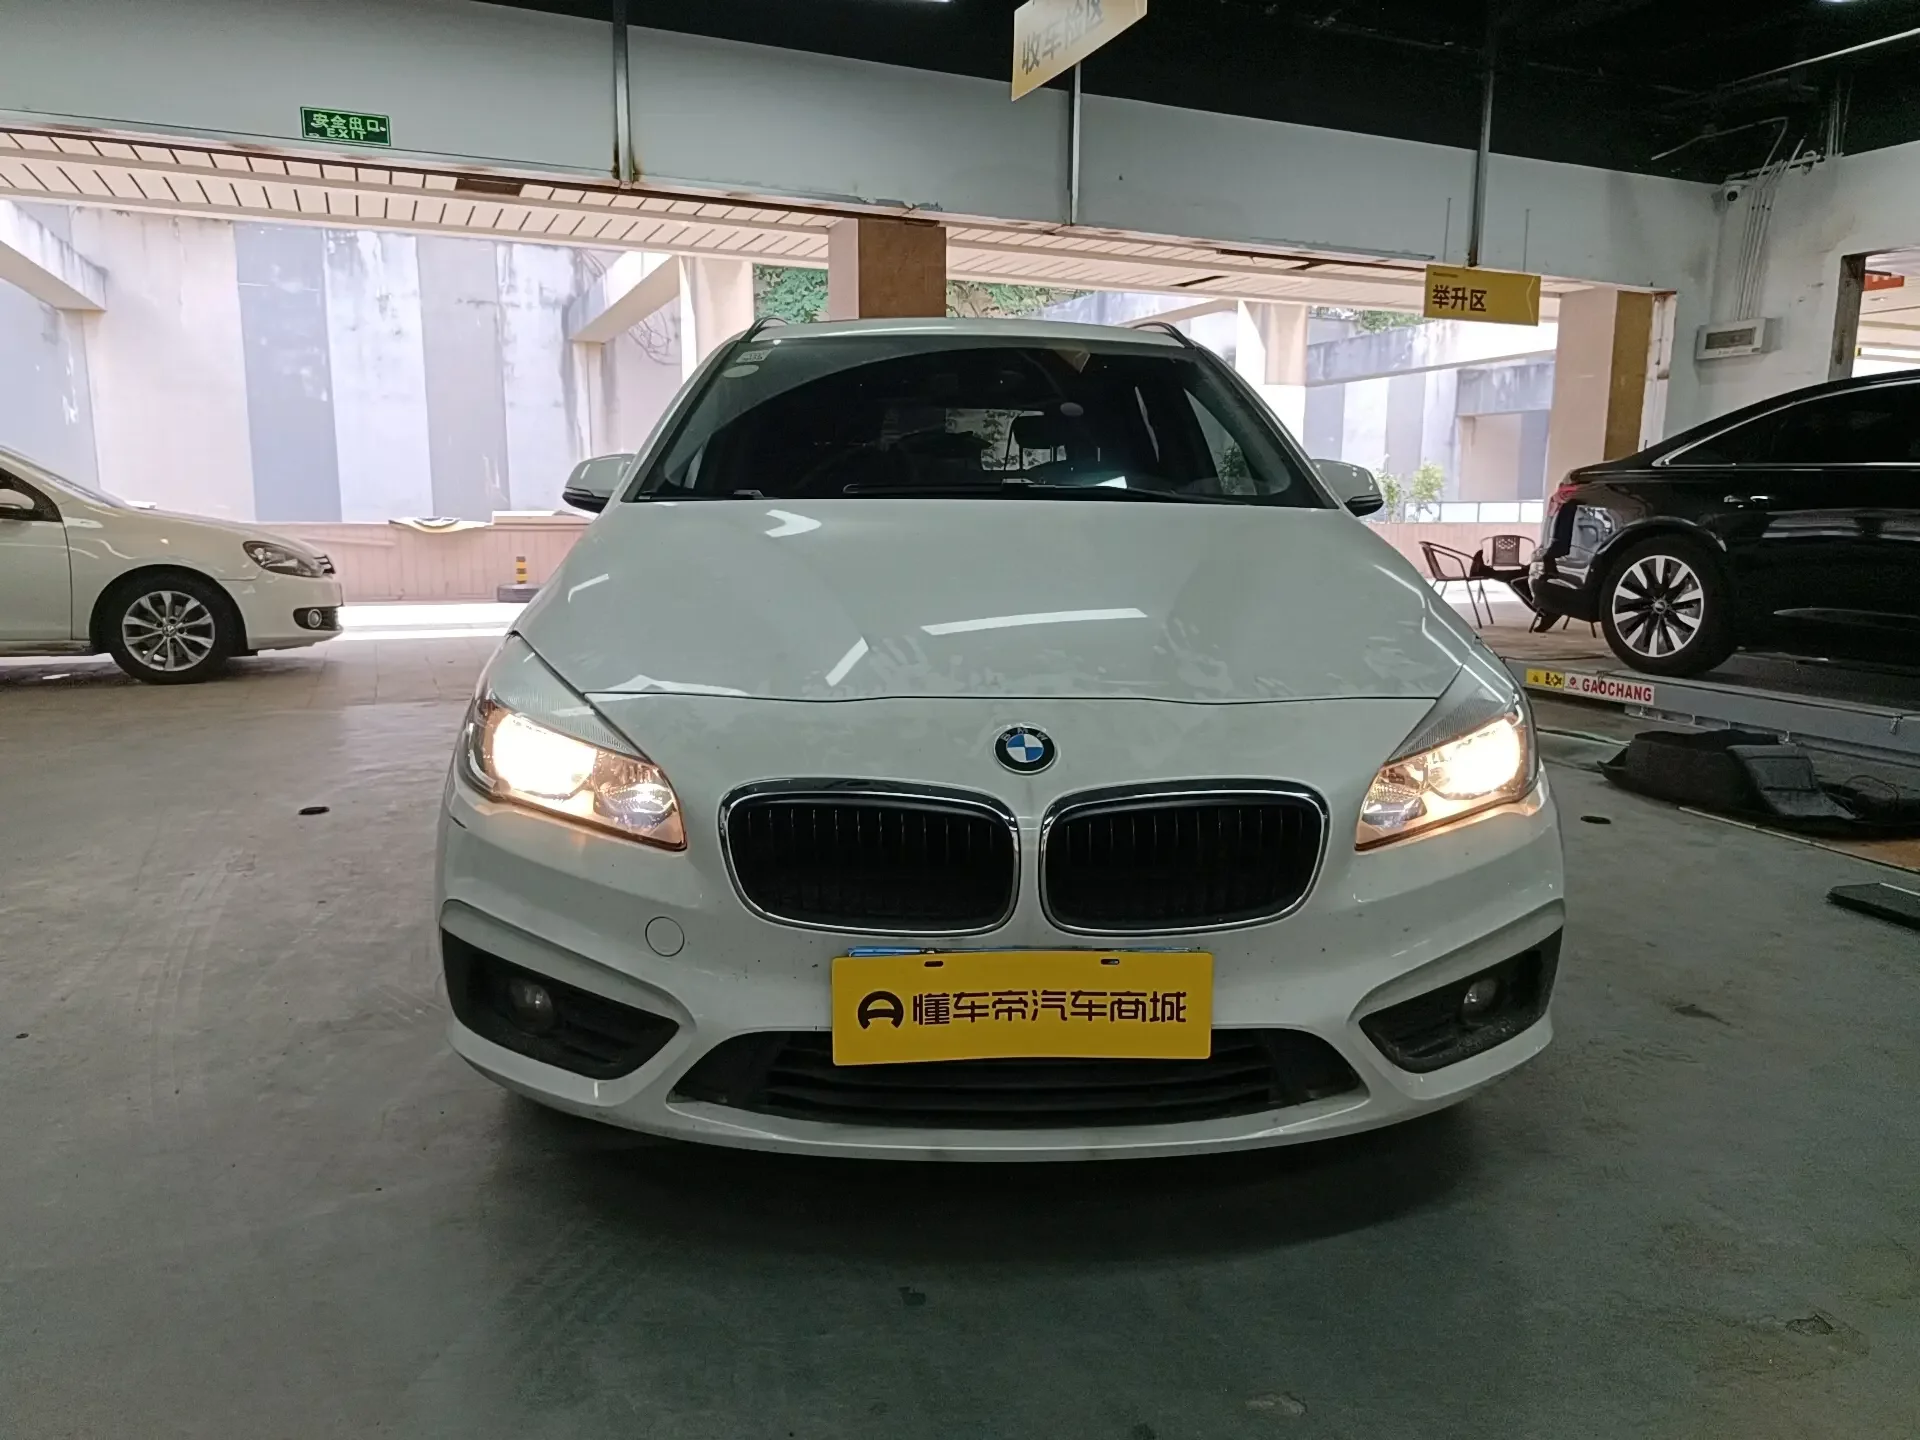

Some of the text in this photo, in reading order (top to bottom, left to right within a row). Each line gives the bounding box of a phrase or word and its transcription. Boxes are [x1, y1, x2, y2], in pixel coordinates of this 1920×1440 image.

[311, 113, 380, 133] 安全出口
[326, 127, 367, 141] EXIT
[1432, 284, 1488, 312] 举升区
[1581, 678, 1653, 702] GAOCHANG
[999, 727, 1049, 742] BMW
[912, 988, 1188, 1026] 懂车帝汽车商城
